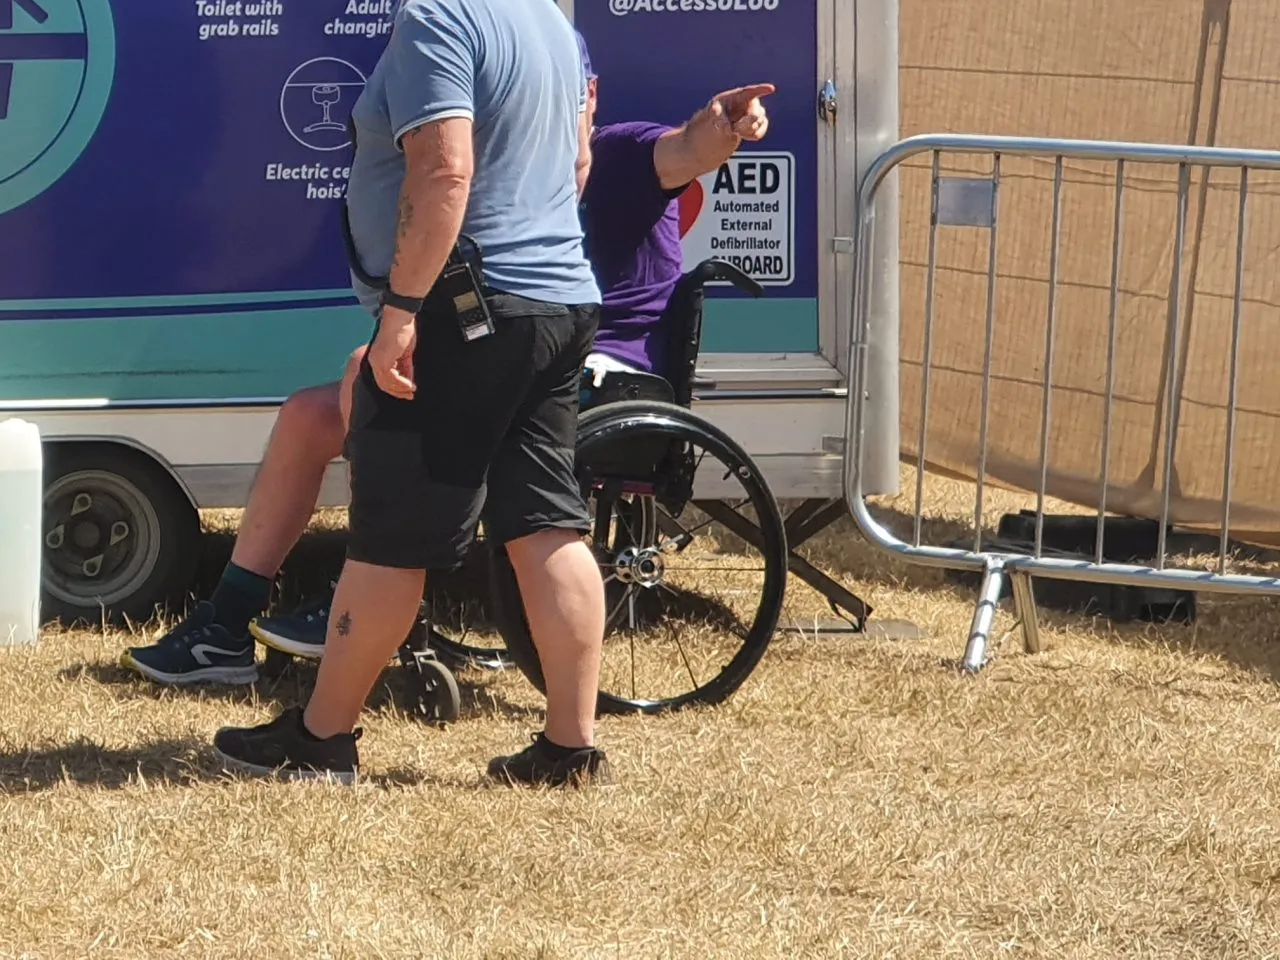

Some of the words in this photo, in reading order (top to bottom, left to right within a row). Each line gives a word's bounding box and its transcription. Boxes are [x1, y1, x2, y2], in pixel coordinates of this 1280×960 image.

[195, 0, 242, 17] Toilet
[199, 19, 240, 40] grab
[242, 18, 279, 36] rails
[266, 162, 329, 180] Electric
[712, 162, 780, 195] AED
[713, 200, 780, 213] Automated
[721, 218, 772, 231] External
[711, 237, 781, 250] Defibrillator
[711, 255, 784, 275] BOARD
